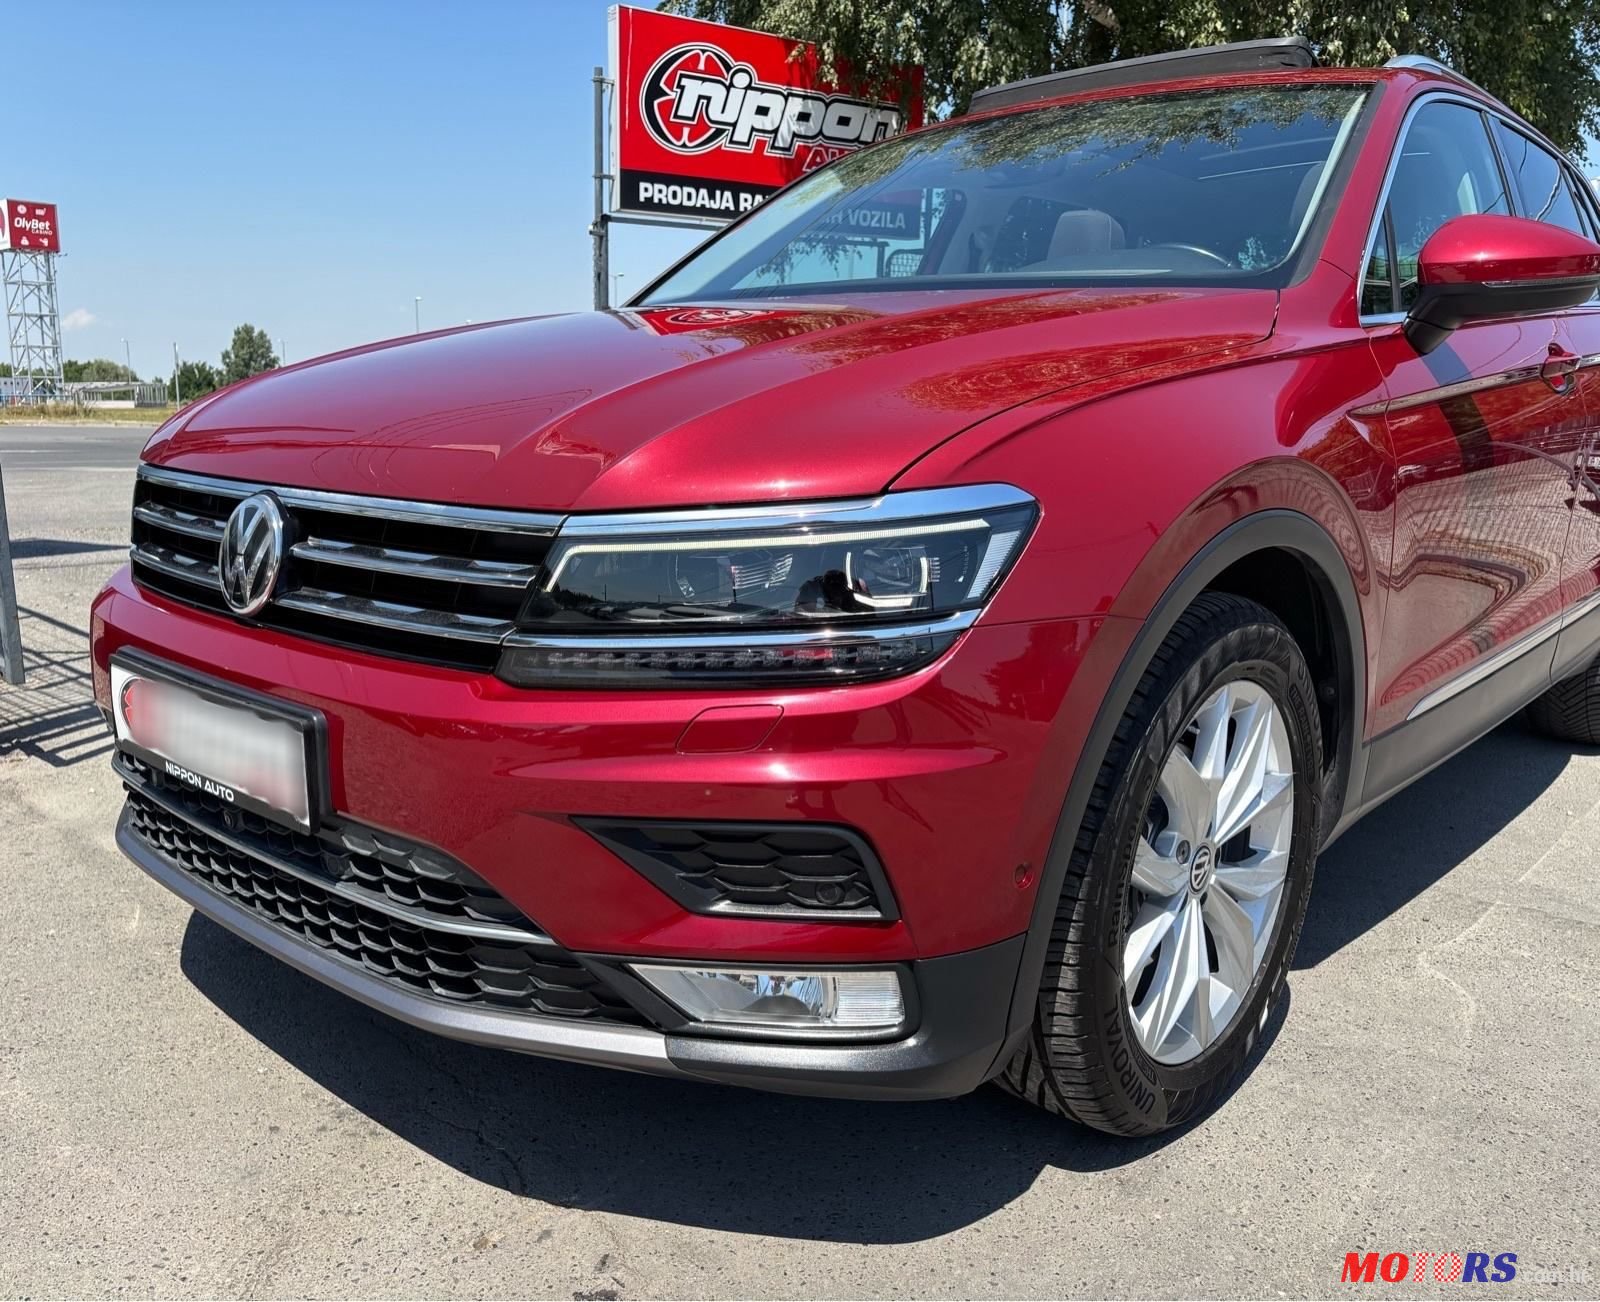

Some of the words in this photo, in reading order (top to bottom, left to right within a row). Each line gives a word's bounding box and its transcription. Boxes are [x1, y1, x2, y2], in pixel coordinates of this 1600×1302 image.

[673, 69, 901, 153] nippon
[14, 217, 50, 231] OlyBet
[638, 181, 735, 211] PRODAJA
[739, 192, 769, 212] RA
[847, 208, 906, 229] VOZILA
[31, 228, 53, 236] CASINO
[165, 760, 202, 789] NIPPON
[204, 779, 235, 803] AUTO
[1103, 992, 1156, 1115] UNIROYAL
